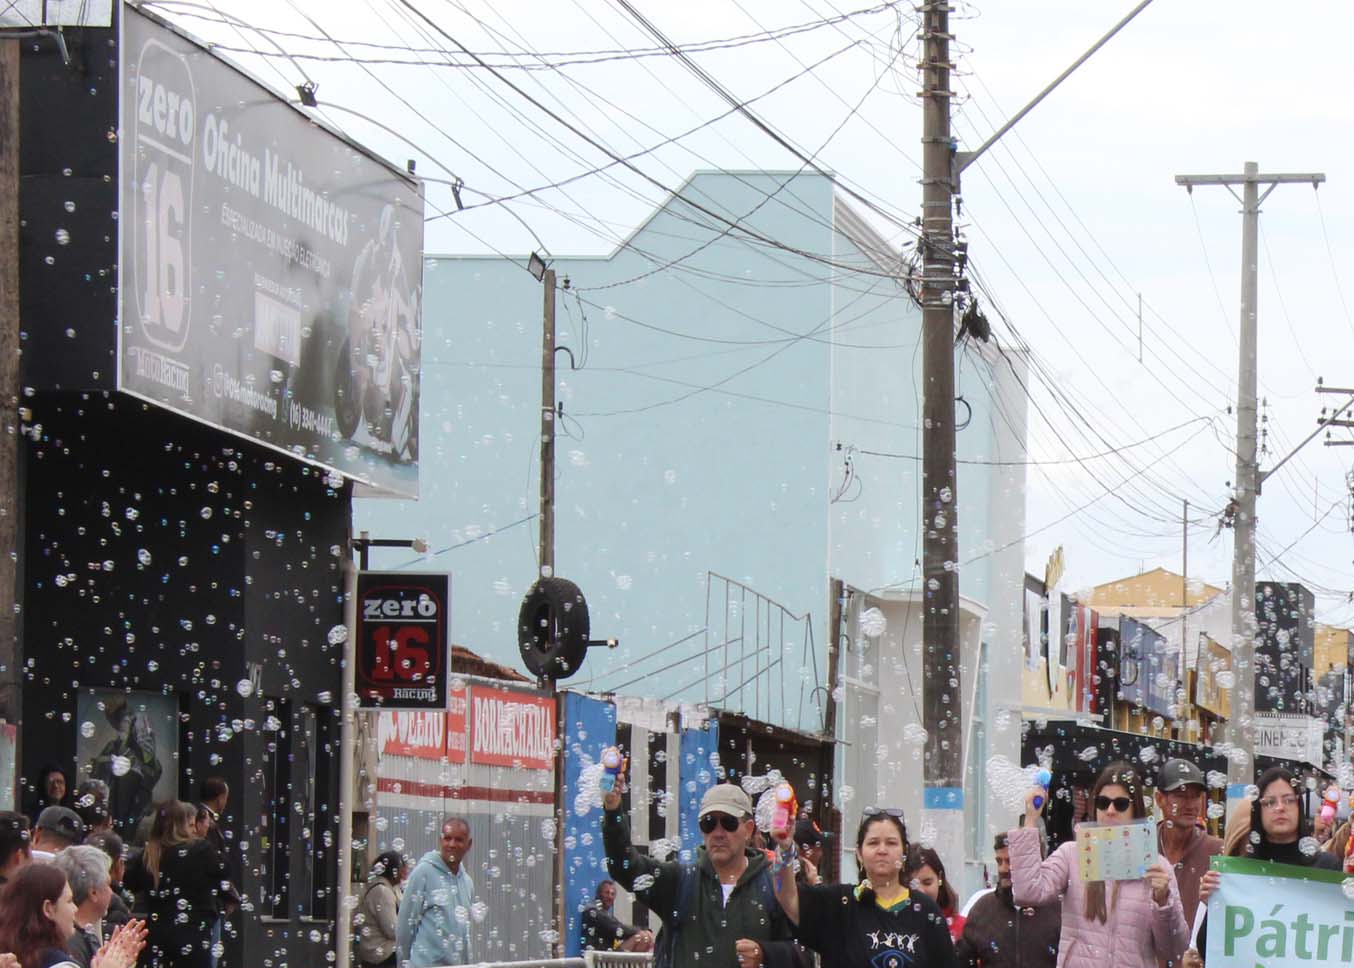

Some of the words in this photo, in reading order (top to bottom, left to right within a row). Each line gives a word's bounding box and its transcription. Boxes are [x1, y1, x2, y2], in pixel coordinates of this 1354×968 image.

[139, 75, 193, 145] zero
[203, 113, 261, 198] Oficina
[264, 148, 349, 246] Multimarcas
[142, 161, 184, 334] 16
[363, 598, 437, 616] zero
[371, 625, 431, 680] 16
[393, 687, 438, 701] Racing
